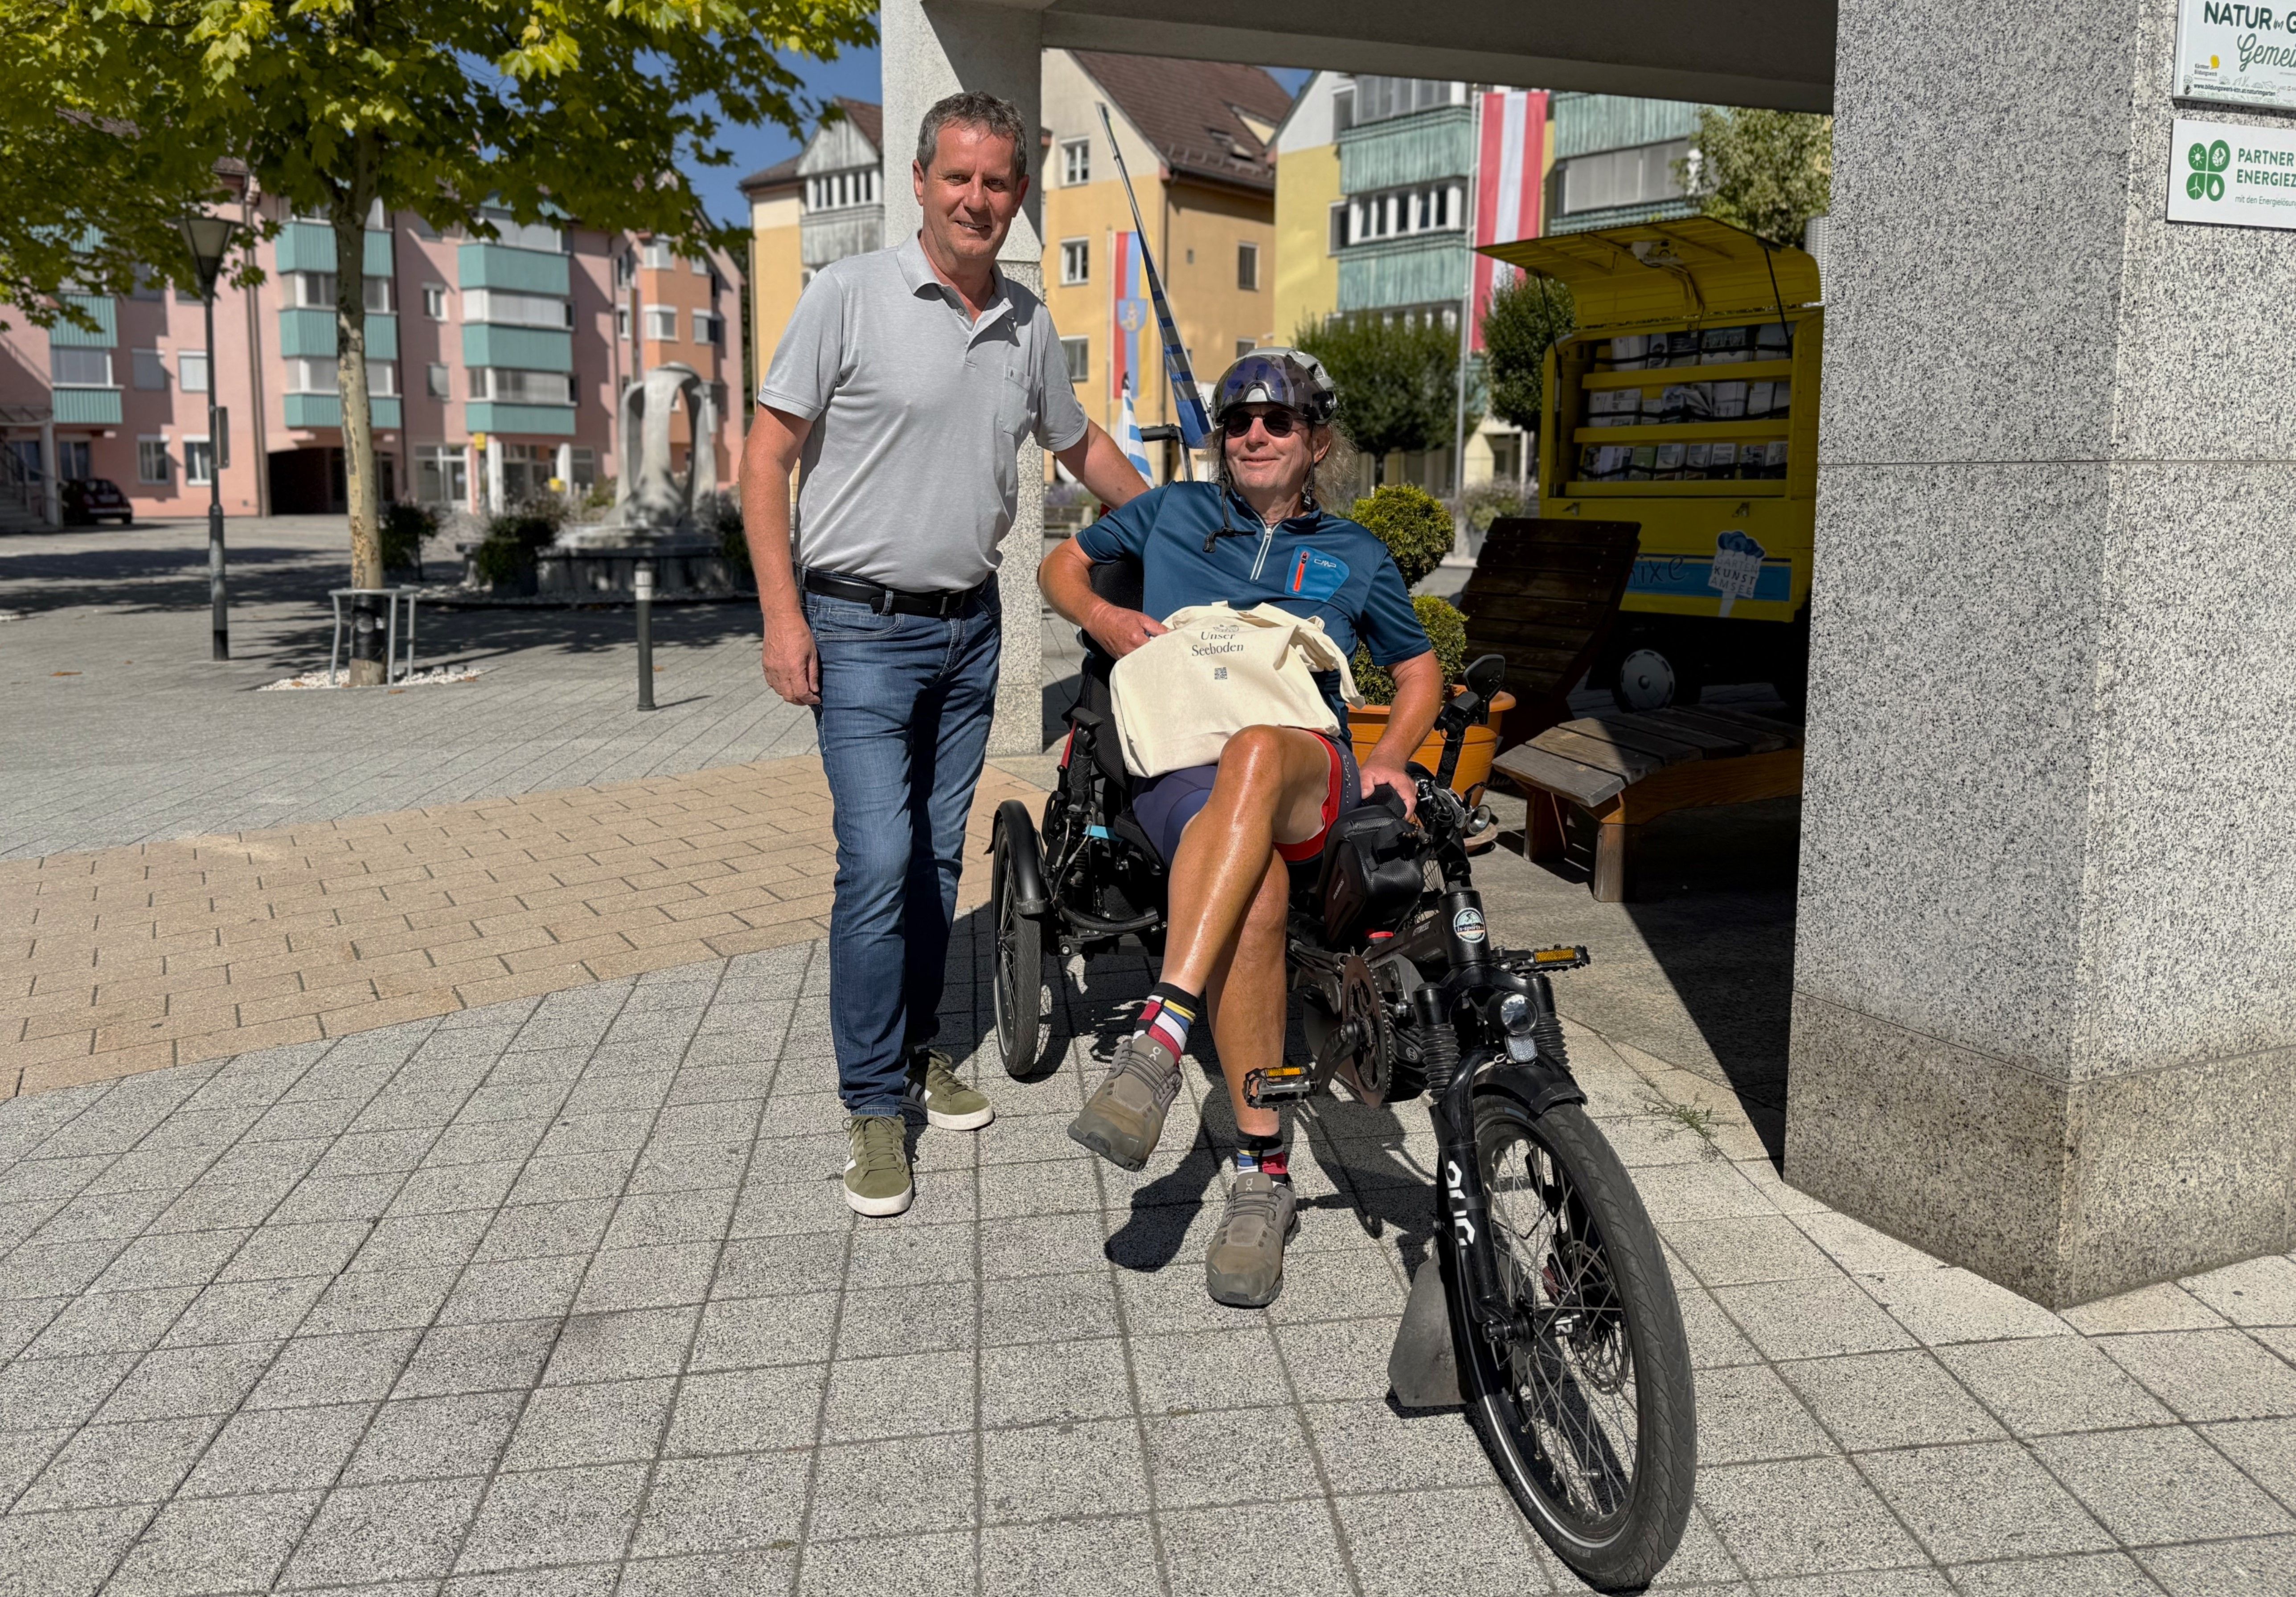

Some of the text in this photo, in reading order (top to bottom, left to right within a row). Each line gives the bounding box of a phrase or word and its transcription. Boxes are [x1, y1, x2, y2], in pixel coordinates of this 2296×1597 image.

[2204, 1, 2272, 30] NATUR
[2238, 148, 2294, 167] PARTNER
[2236, 169, 2296, 187] ENERGIEZ
[2235, 195, 2296, 208] mit den Energielösun
[1314, 559, 1337, 568] CMP
[1716, 557, 1758, 574] GARTEN
[1714, 565, 1755, 585] KUNST
[1201, 631, 1235, 640] Unser
[1192, 642, 1244, 656] Seeboden
